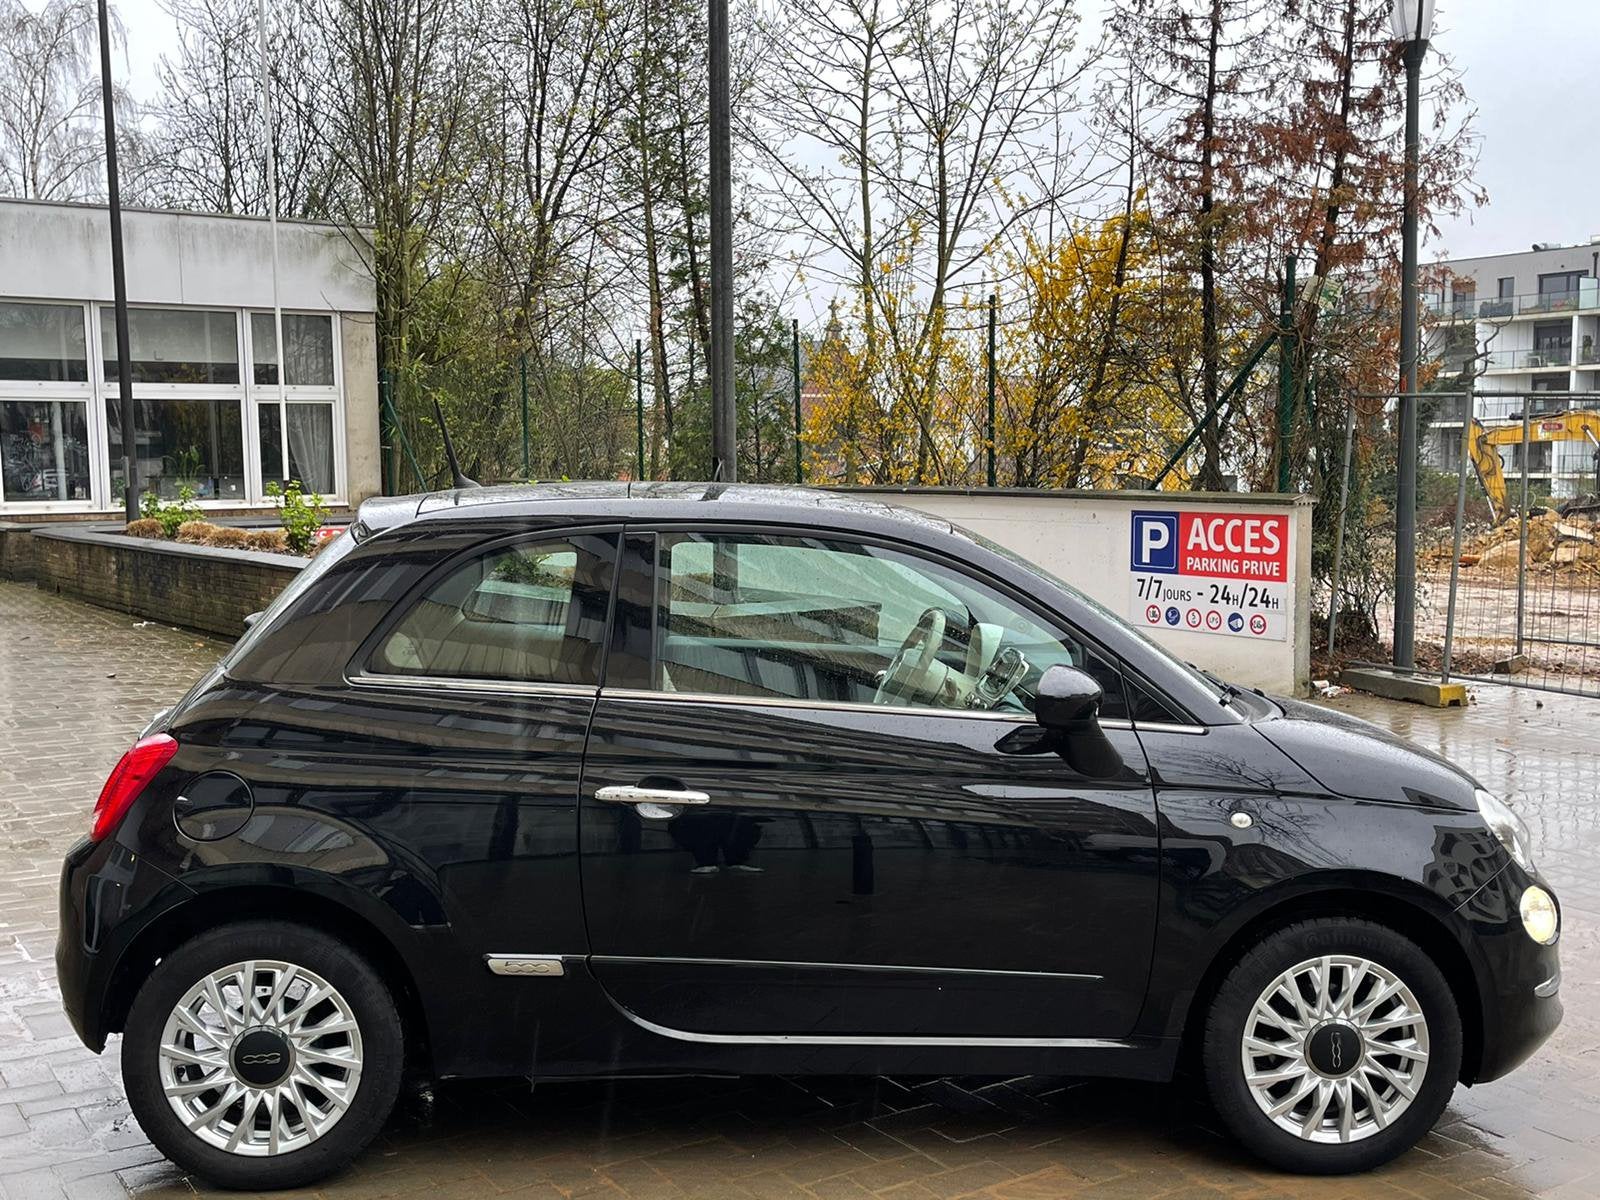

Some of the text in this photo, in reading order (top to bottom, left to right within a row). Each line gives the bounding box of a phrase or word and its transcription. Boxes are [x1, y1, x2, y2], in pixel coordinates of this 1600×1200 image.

[1142, 521, 1169, 563] P
[1187, 518, 1280, 555] ACCES
[1187, 557, 1280, 577] PARKING PRIVE
[1210, 583, 1279, 610] 24H/24H
